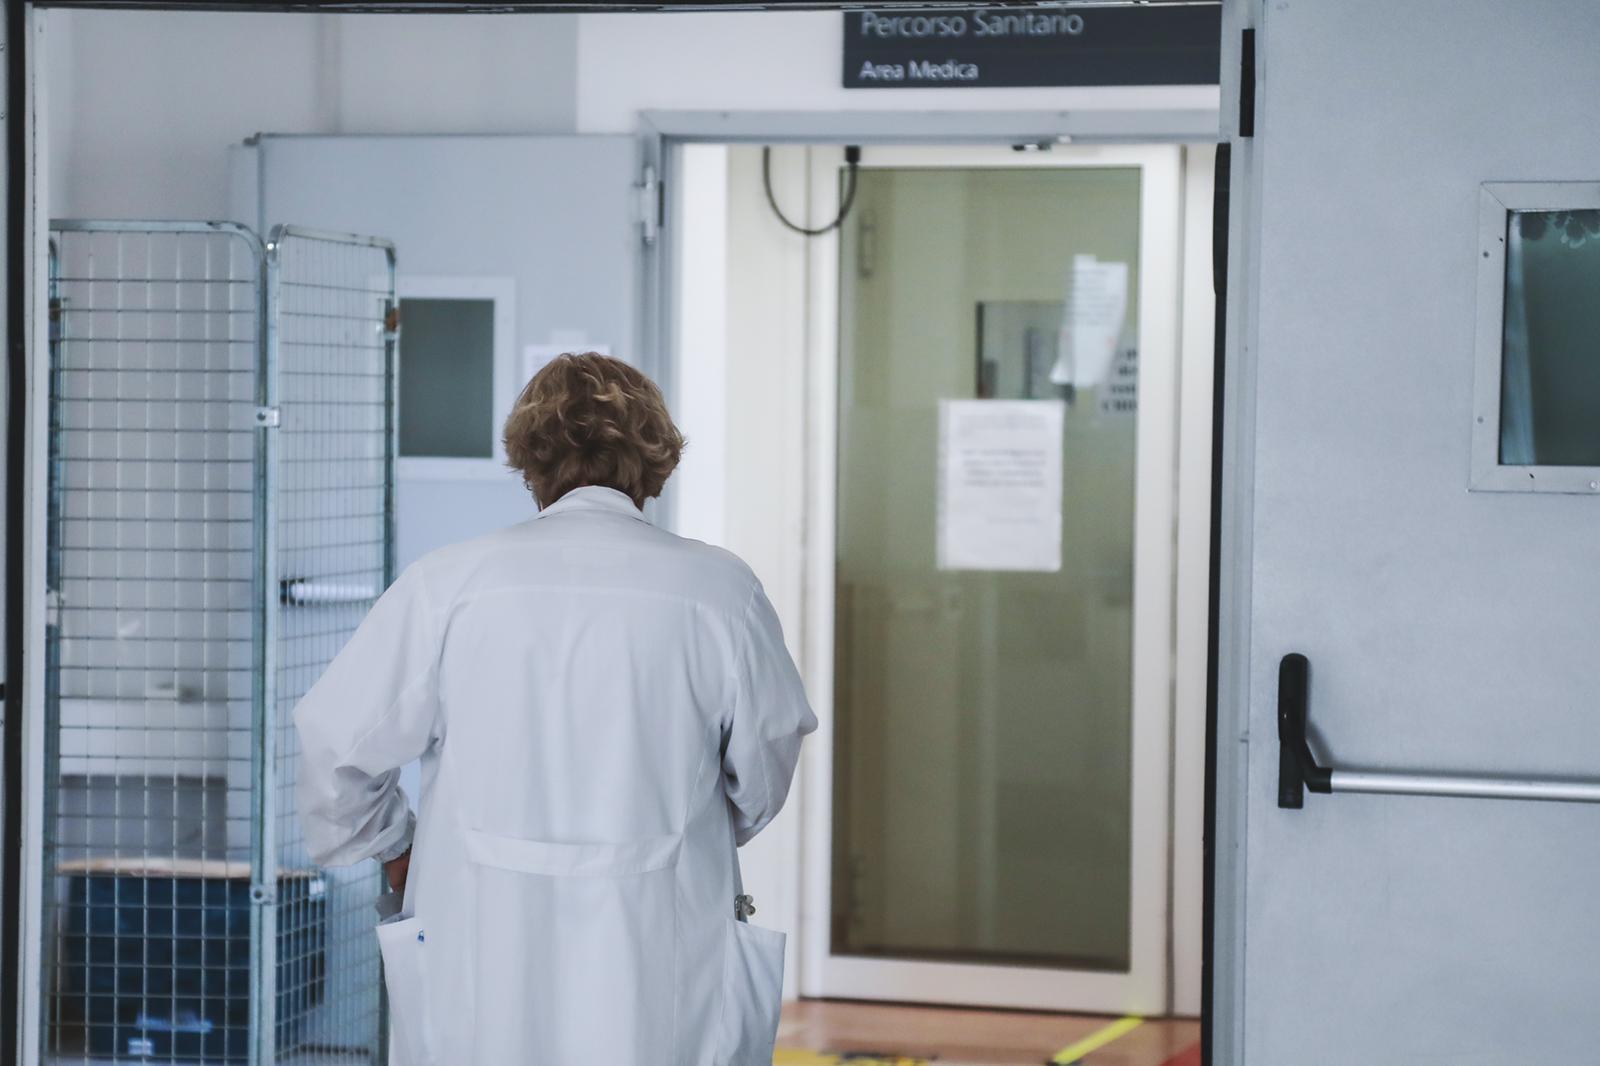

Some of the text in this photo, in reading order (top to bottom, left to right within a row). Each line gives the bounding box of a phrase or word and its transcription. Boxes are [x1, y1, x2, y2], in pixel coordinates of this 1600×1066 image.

[861, 10, 1083, 37] Percorso Sanitario
[859, 60, 978, 80] Area Medica
